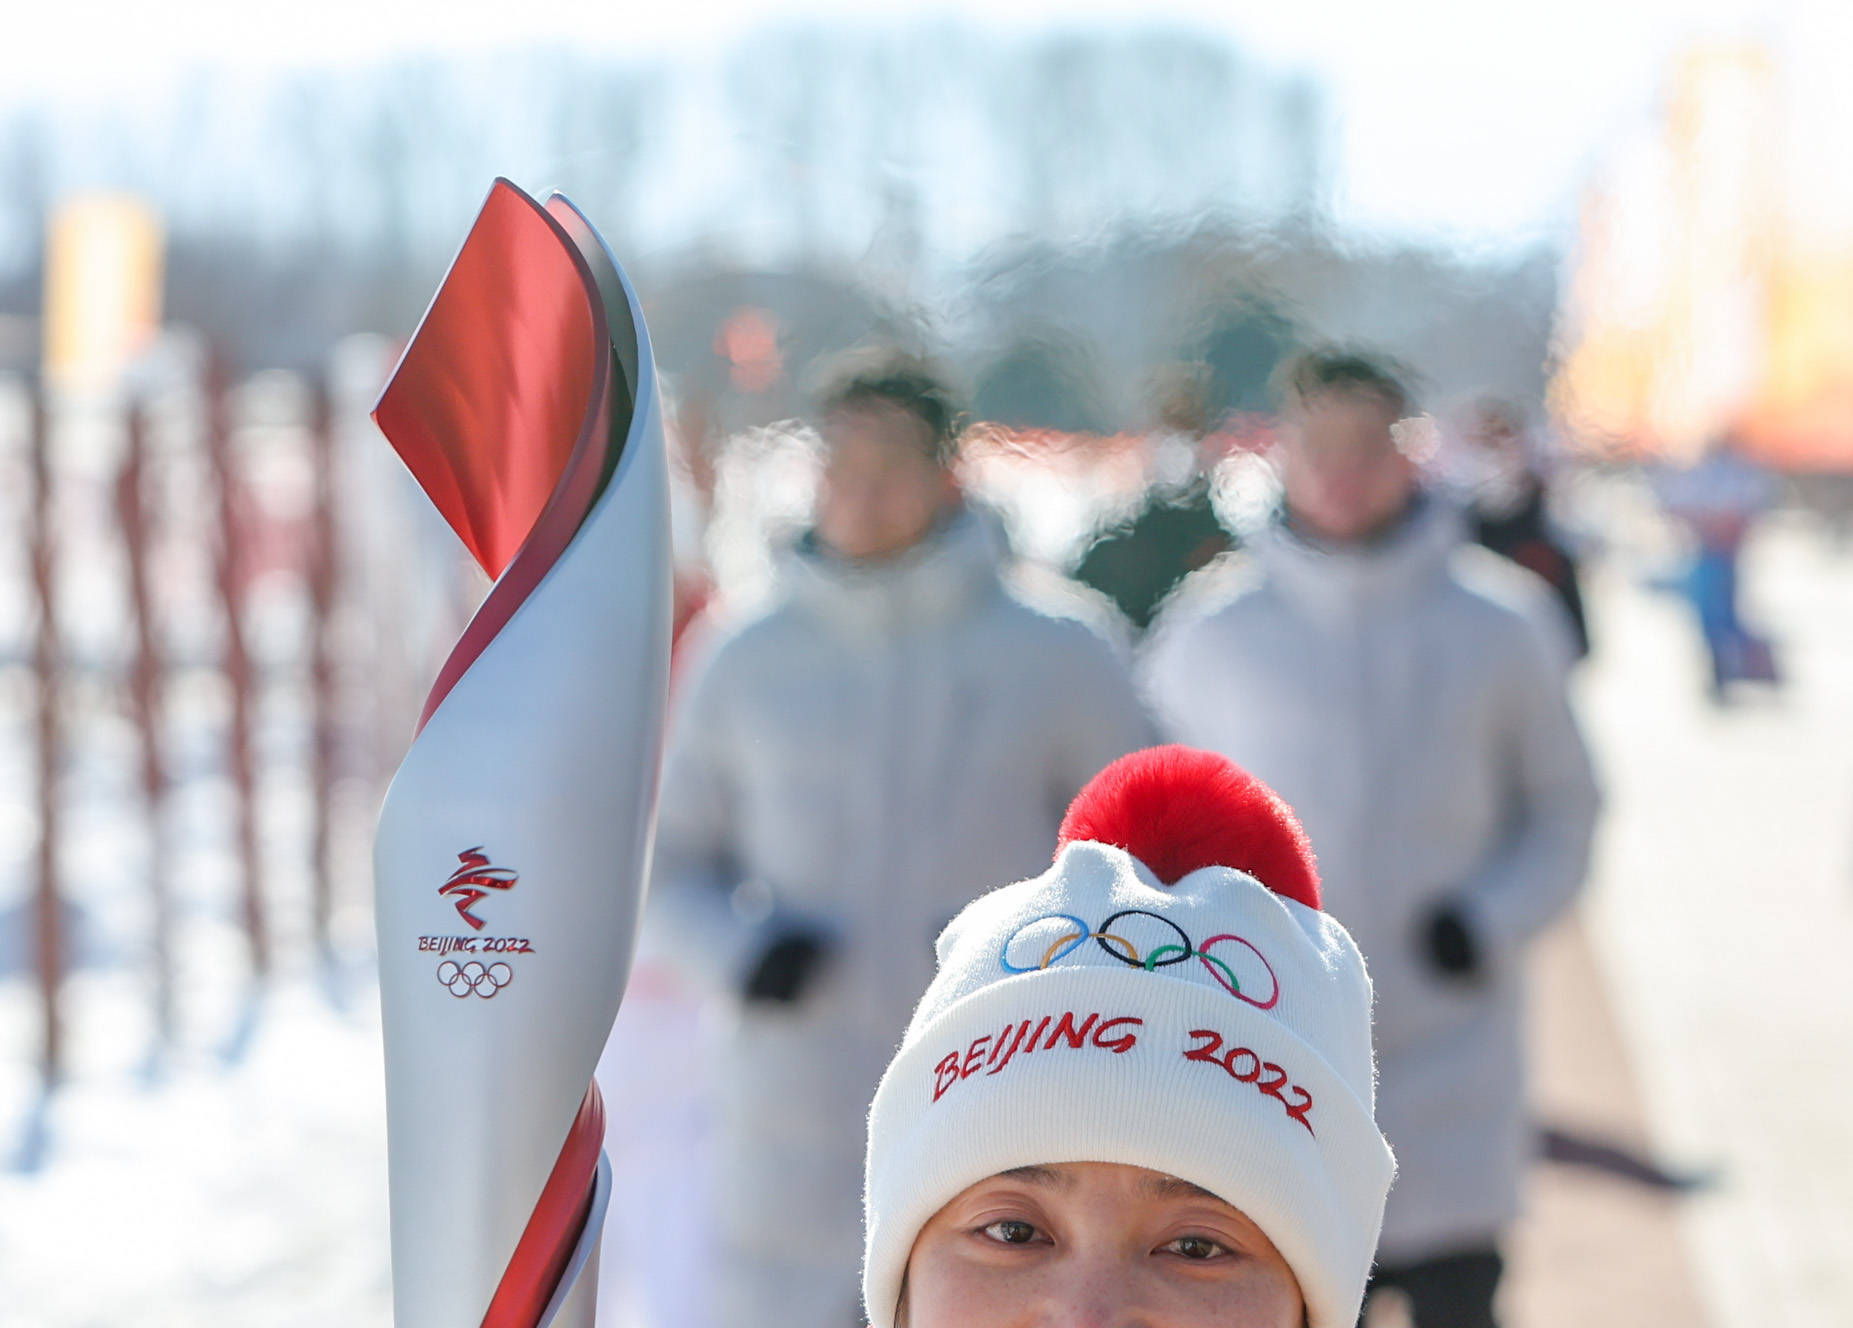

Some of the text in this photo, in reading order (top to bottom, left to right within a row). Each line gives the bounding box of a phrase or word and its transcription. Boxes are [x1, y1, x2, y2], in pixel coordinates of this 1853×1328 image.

[418, 936, 536, 955] BEIJING 2022
[932, 1011, 1316, 1138] BEIJING 2022
